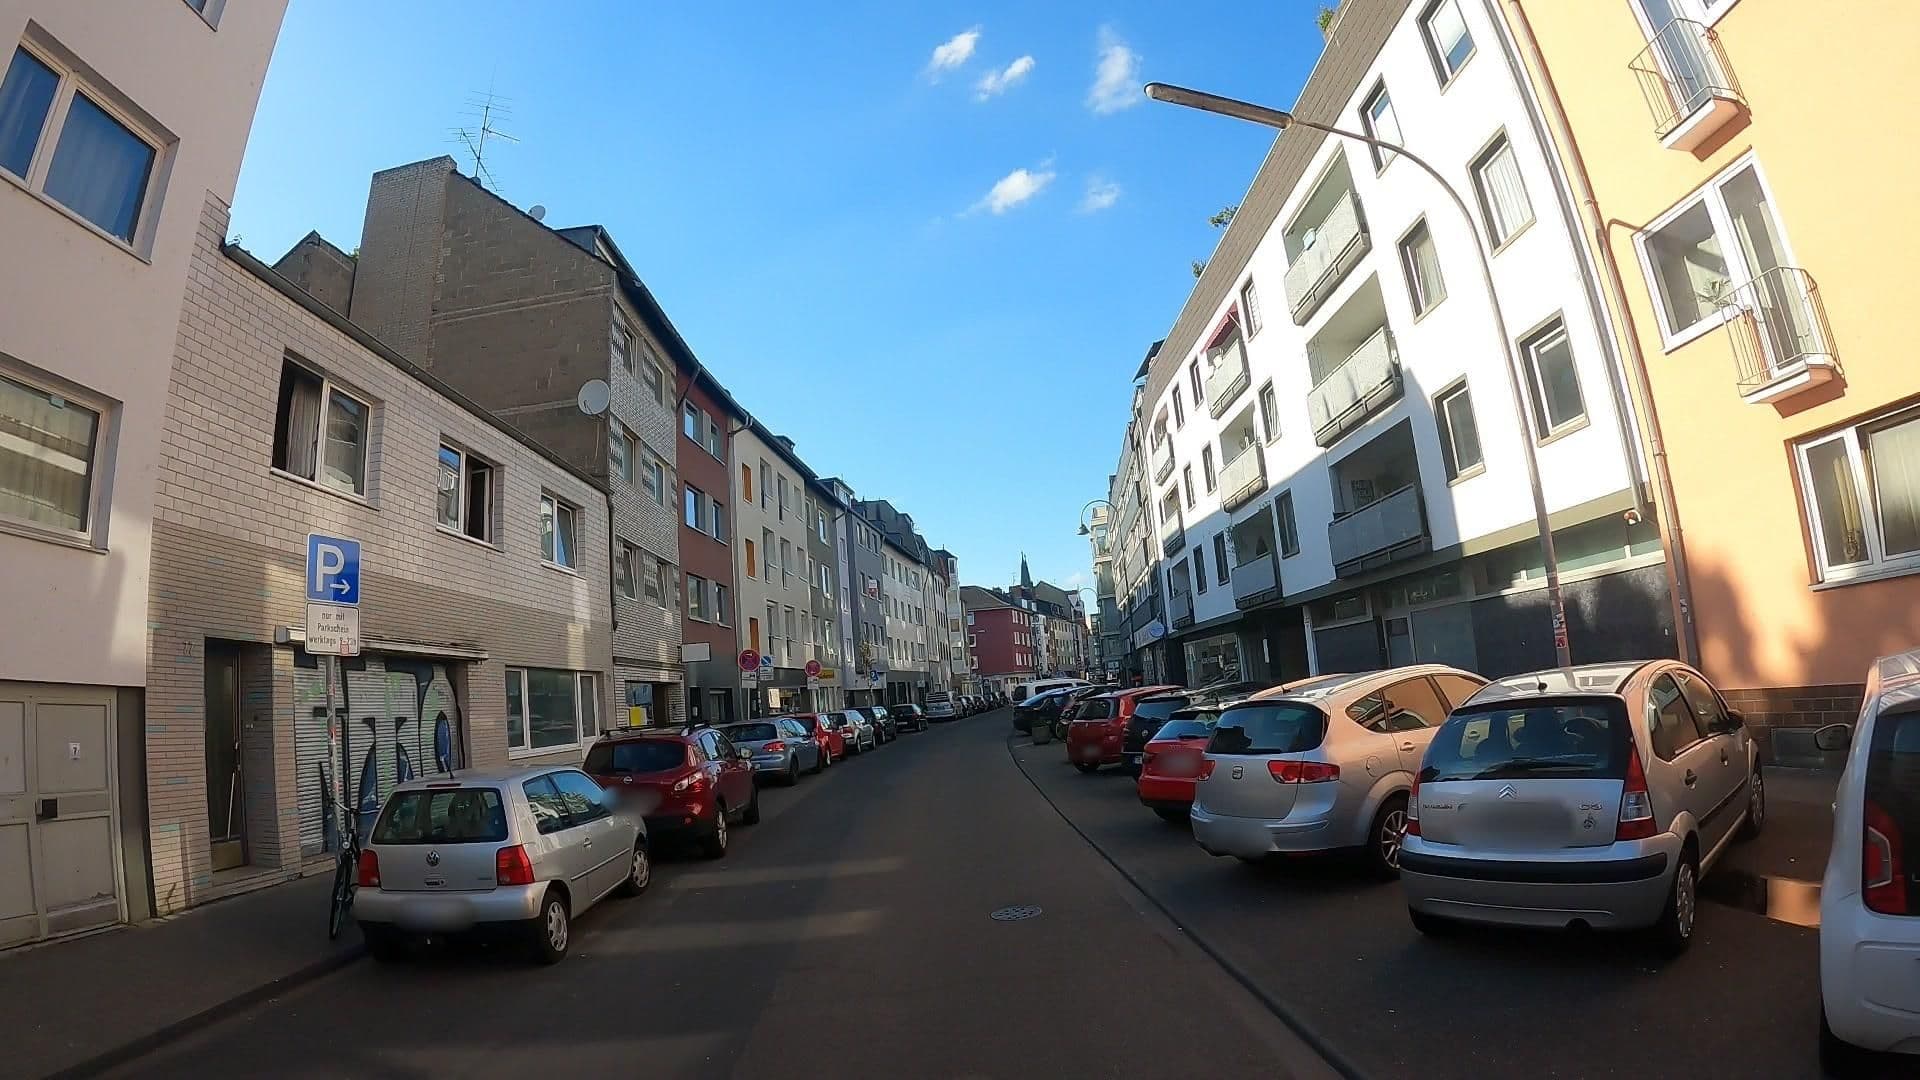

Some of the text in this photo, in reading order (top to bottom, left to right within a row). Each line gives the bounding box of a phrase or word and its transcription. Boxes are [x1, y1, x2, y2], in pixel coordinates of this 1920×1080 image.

[315, 543, 345, 592] P
[321, 612, 345, 621] nur mit
[317, 623, 349, 633] Parkschein
[309, 635, 337, 647] werktags
